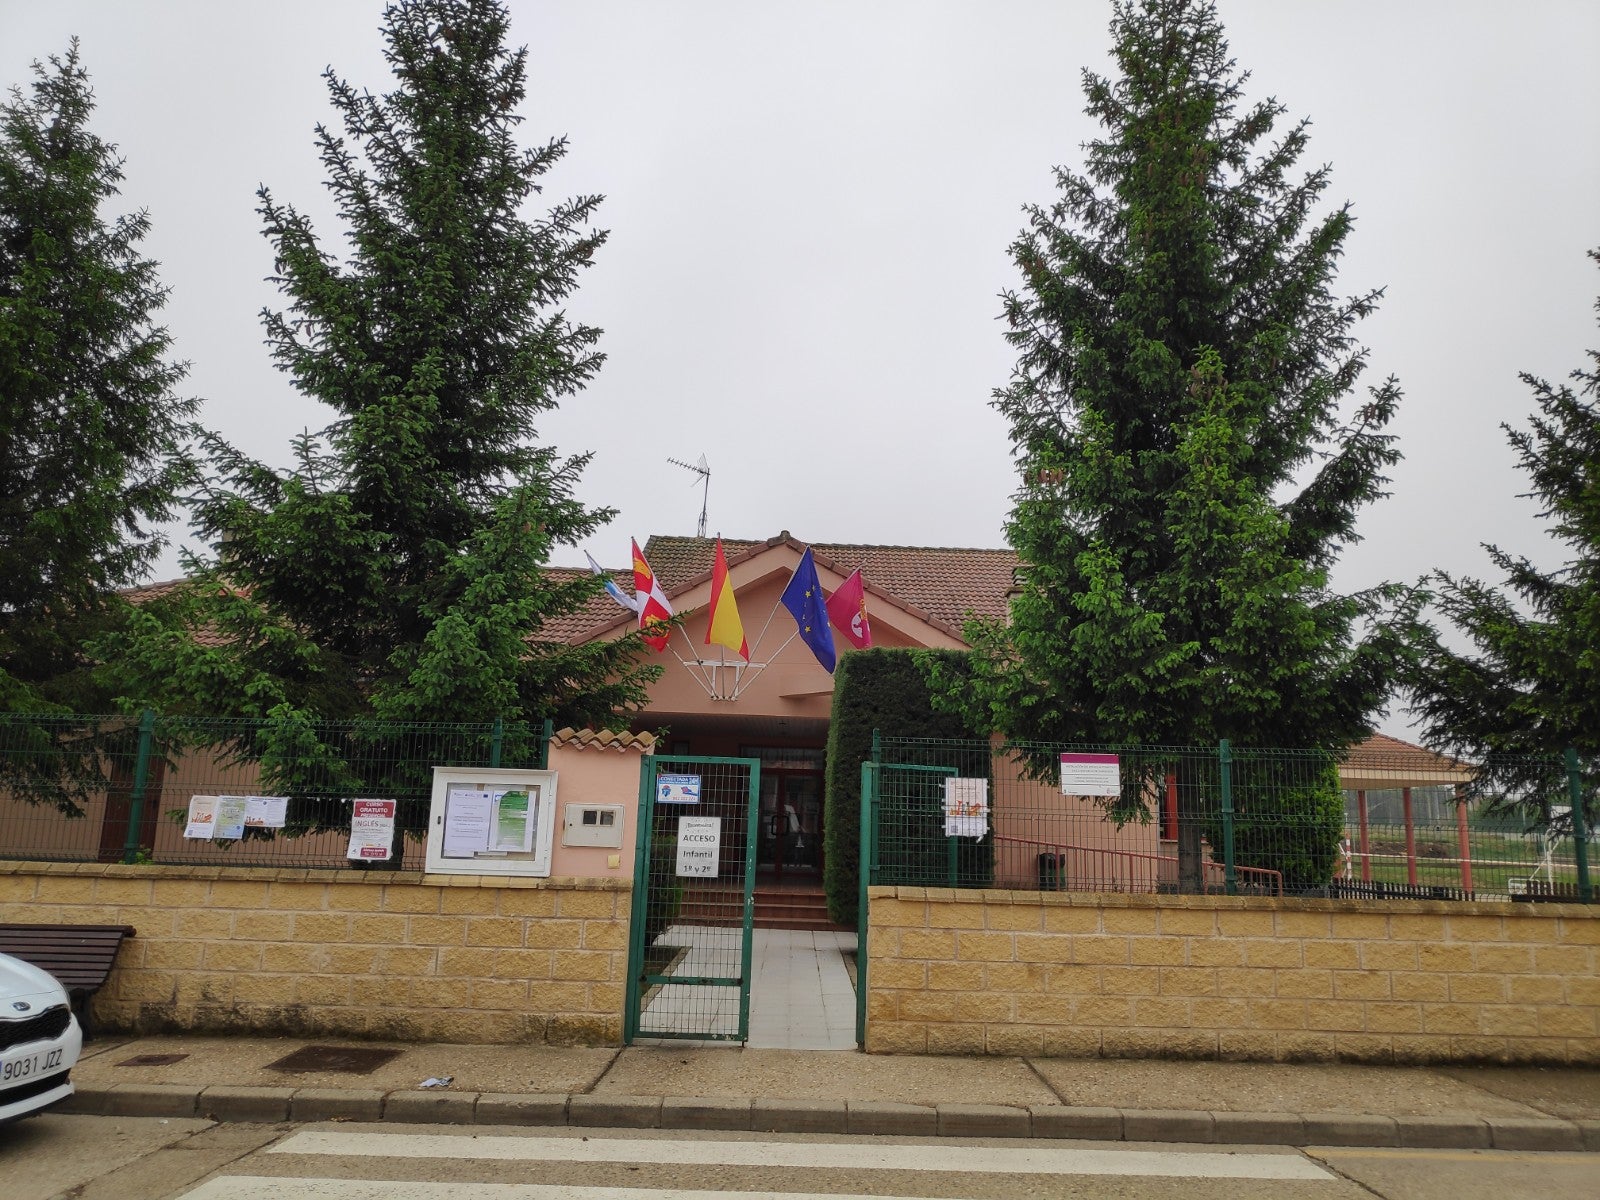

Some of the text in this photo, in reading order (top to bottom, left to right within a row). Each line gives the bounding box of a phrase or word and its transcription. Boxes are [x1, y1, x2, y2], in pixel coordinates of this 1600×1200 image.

[682, 834, 716, 843] ACCESO
[682, 851, 713, 859] Infantil
[694, 867, 698, 875] y
[4, 1048, 63, 1081] 9031 JZZ
